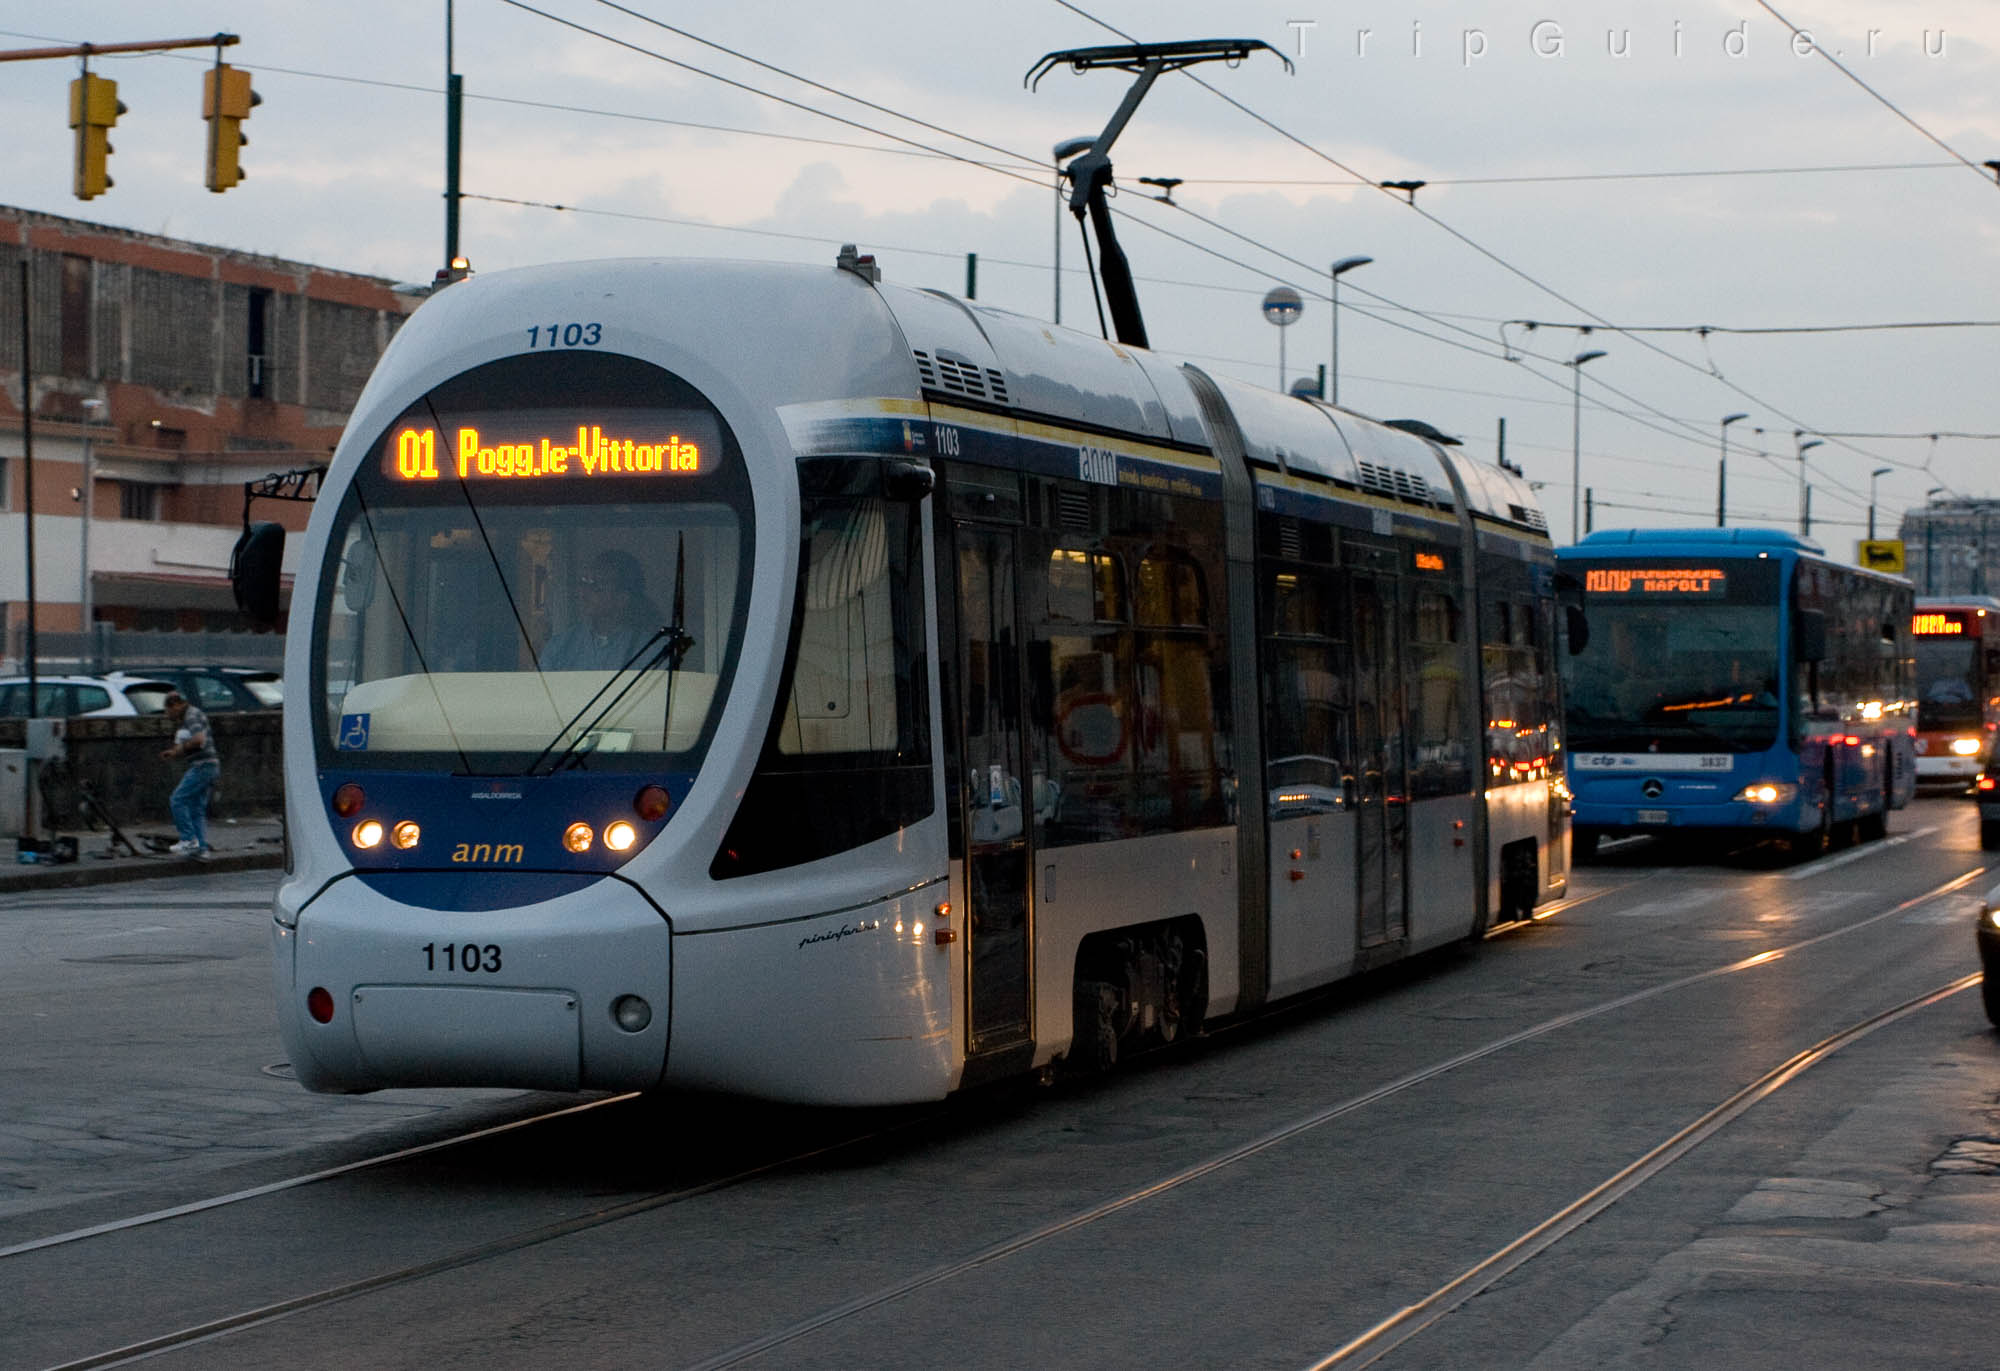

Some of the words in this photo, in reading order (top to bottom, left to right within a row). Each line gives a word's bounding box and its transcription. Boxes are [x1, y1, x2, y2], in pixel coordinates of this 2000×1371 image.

[527, 323, 602, 348] 1103
[399, 430, 438, 478] 01
[458, 427, 698, 477] Pogg.le-Vittoria
[935, 425, 960, 456] 1103
[1081, 446, 1115, 485] anm
[452, 843, 524, 863] anm
[422, 942, 502, 973] 1103
